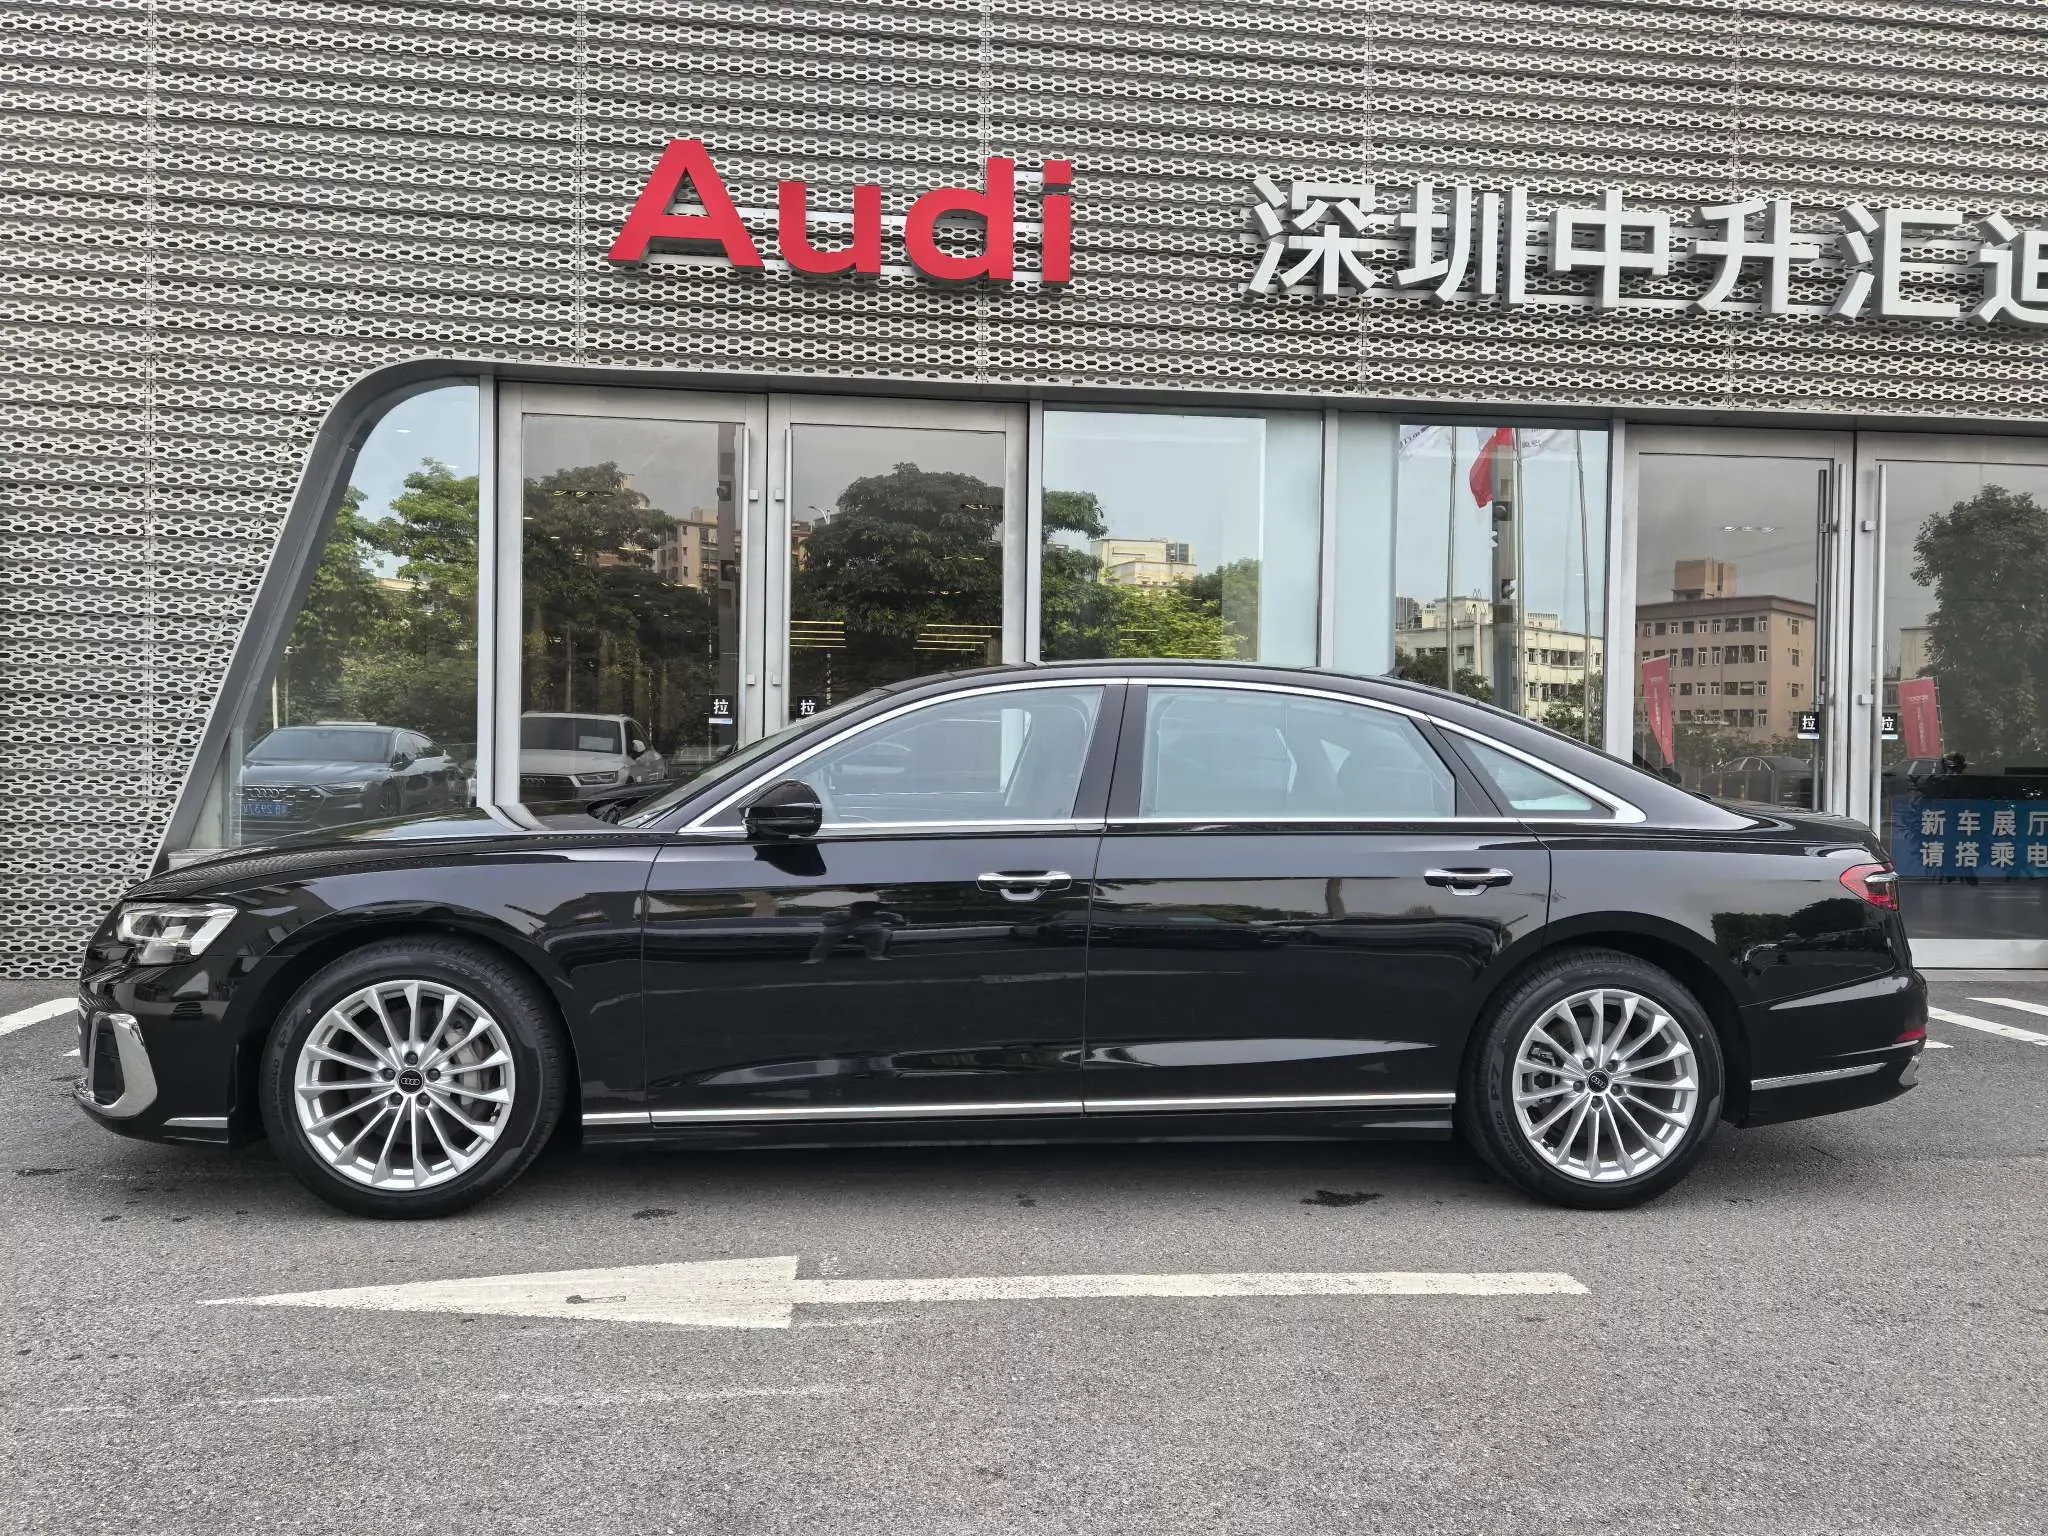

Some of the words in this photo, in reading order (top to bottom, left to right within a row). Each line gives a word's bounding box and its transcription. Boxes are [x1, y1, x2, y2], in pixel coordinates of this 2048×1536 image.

[607, 138, 1074, 286] Audi
[713, 698, 729, 715] 拉
[800, 699, 816, 716] 拉
[1801, 714, 1816, 731] 拉
[1881, 716, 1895, 732] 拉
[1920, 808, 2048, 837] 新车展厅
[1919, 840, 2048, 869] 请搭乘电
